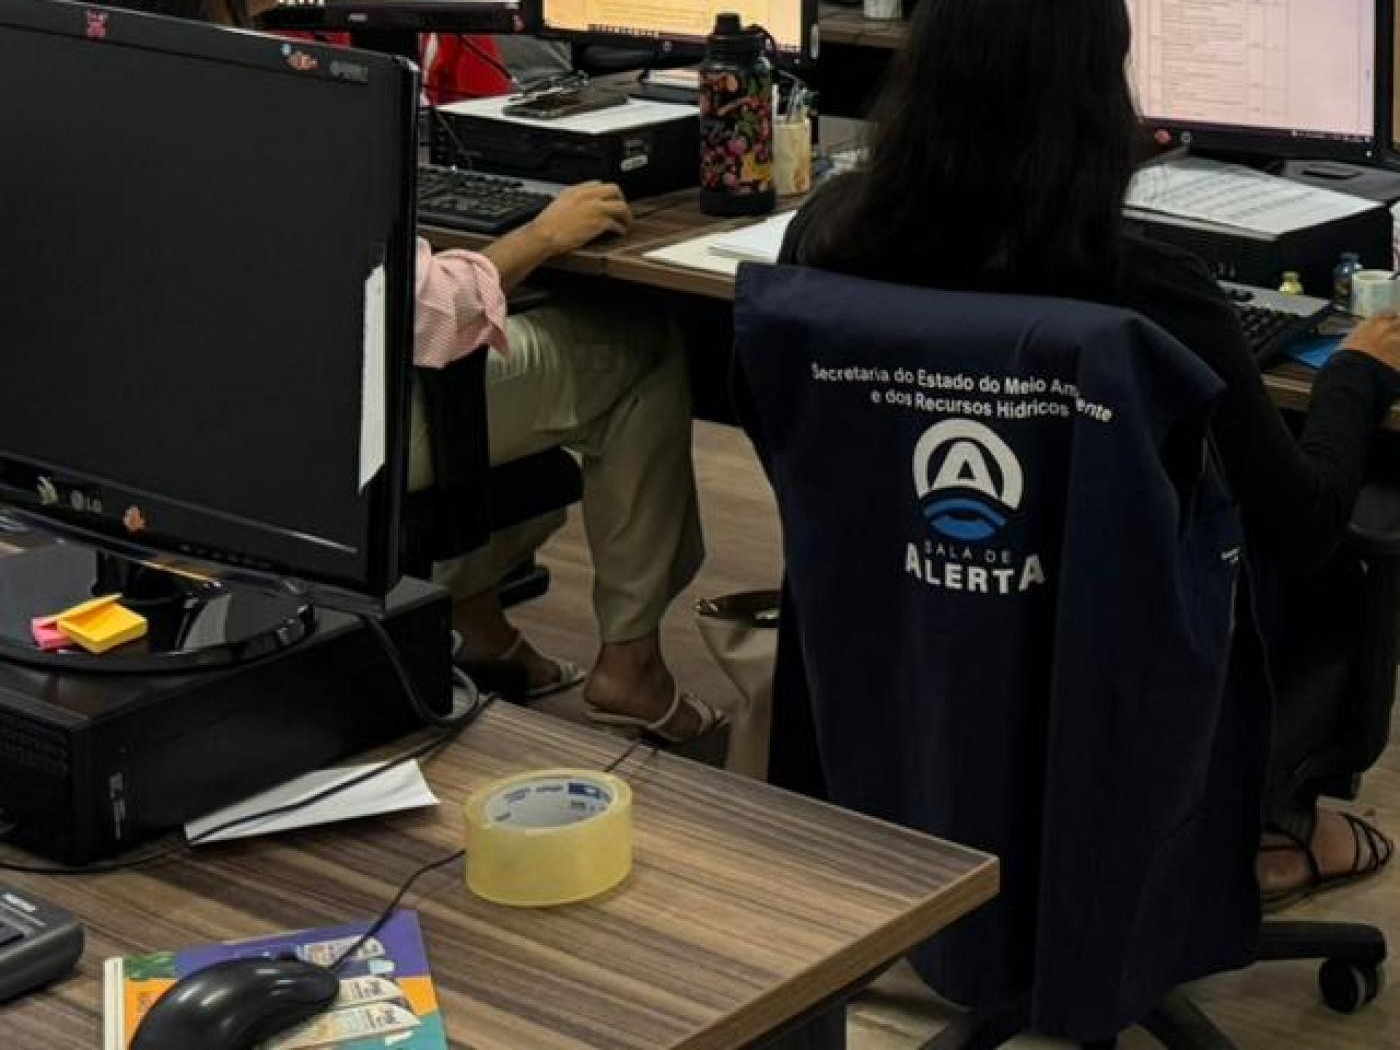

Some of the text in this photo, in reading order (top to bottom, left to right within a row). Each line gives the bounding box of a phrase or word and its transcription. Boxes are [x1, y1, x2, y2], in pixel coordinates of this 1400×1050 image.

[811, 360, 889, 382] Secretaria
[917, 368, 975, 391] Estado
[979, 373, 1001, 394] do
[1003, 375, 1047, 396] Meio
[871, 389, 882, 404] e
[885, 388, 912, 408] dos
[914, 391, 992, 417] Recursos
[904, 540, 1046, 596] ALERTA
[984, 548, 1008, 565] DE
